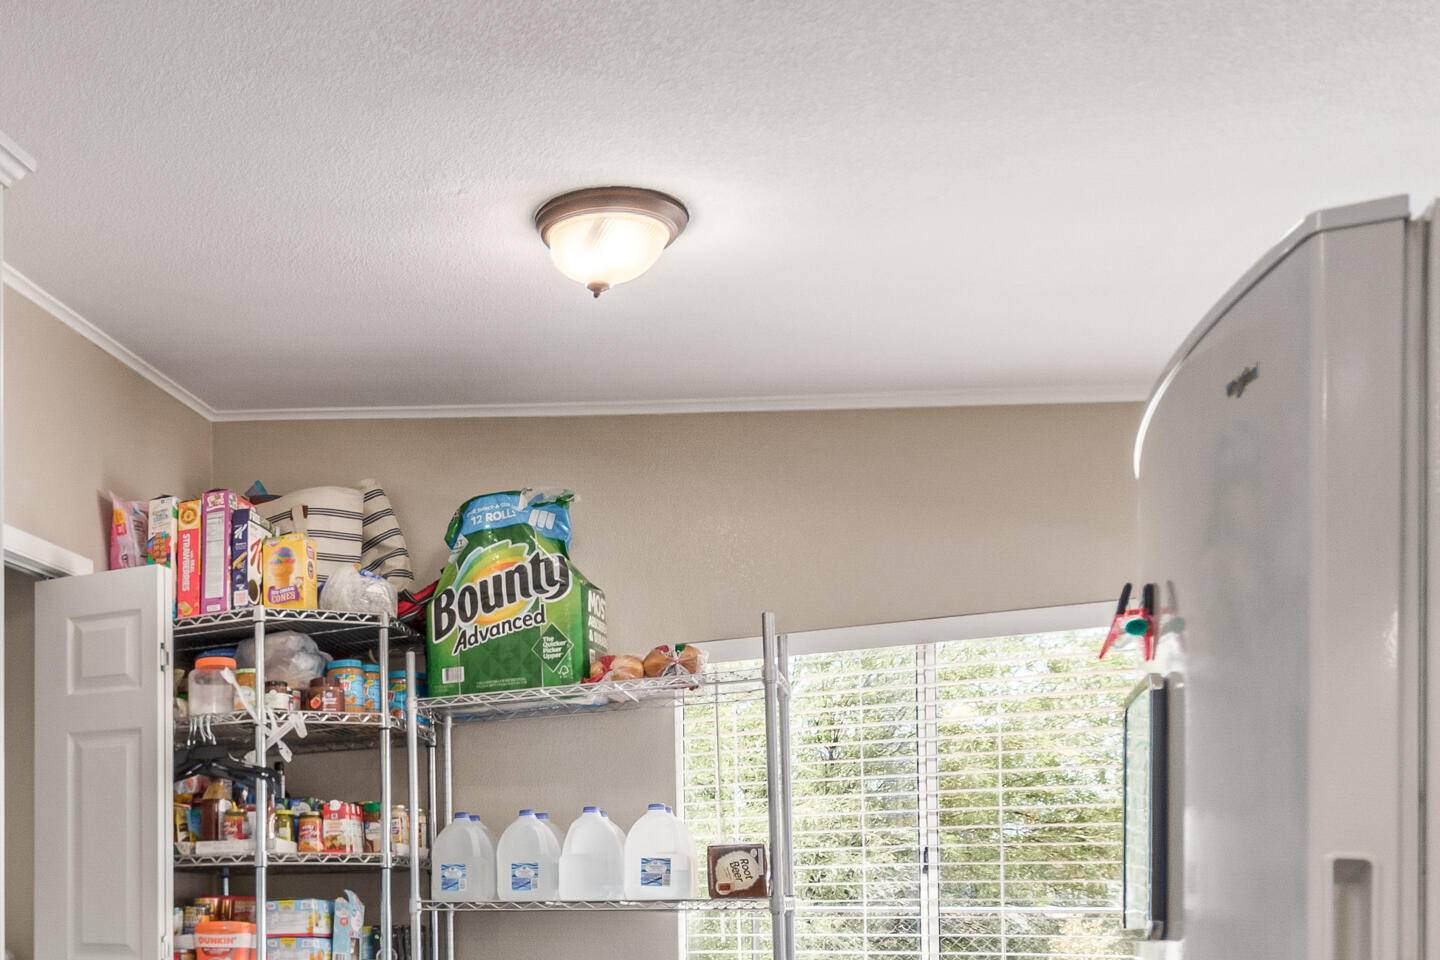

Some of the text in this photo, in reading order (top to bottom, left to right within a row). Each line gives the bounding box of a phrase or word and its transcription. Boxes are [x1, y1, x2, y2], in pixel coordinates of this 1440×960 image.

[471, 515, 482, 525] 12
[182, 533, 191, 592] STRAWBERRIES
[433, 552, 569, 642] Bounty
[453, 604, 545, 655] Advanced
[543, 641, 567, 649] Quicker
[730, 861, 743, 882] Beer
[740, 858, 753, 880] Root
